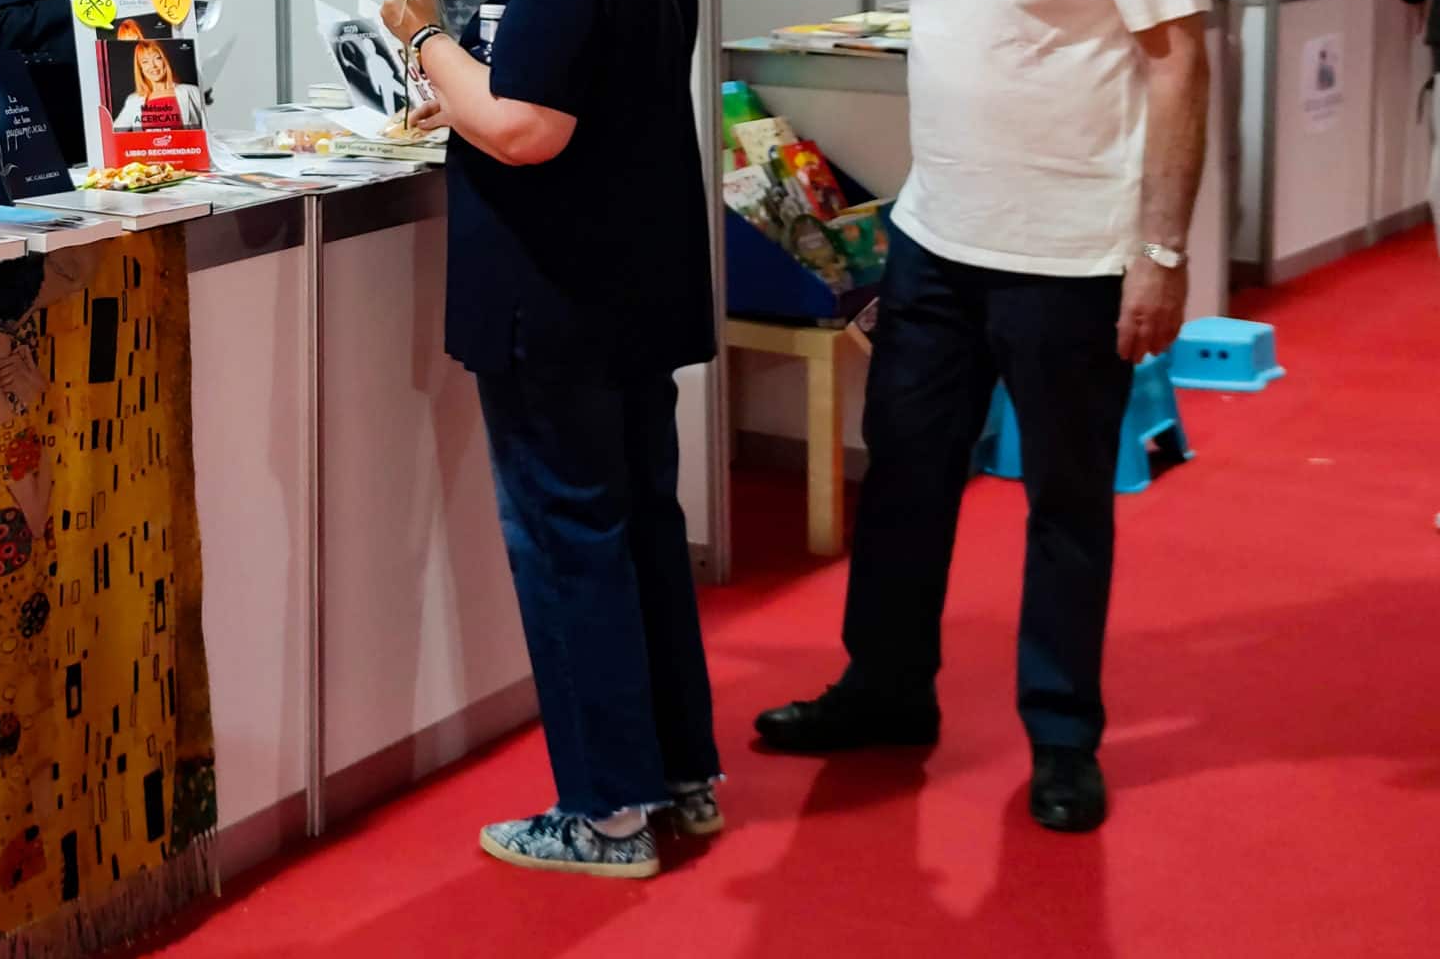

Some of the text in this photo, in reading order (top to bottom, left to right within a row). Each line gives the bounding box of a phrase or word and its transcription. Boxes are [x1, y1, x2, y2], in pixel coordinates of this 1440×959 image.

[166, 5, 179, 20] €
[125, 146, 202, 158] LIBRO RECOMENDADO
